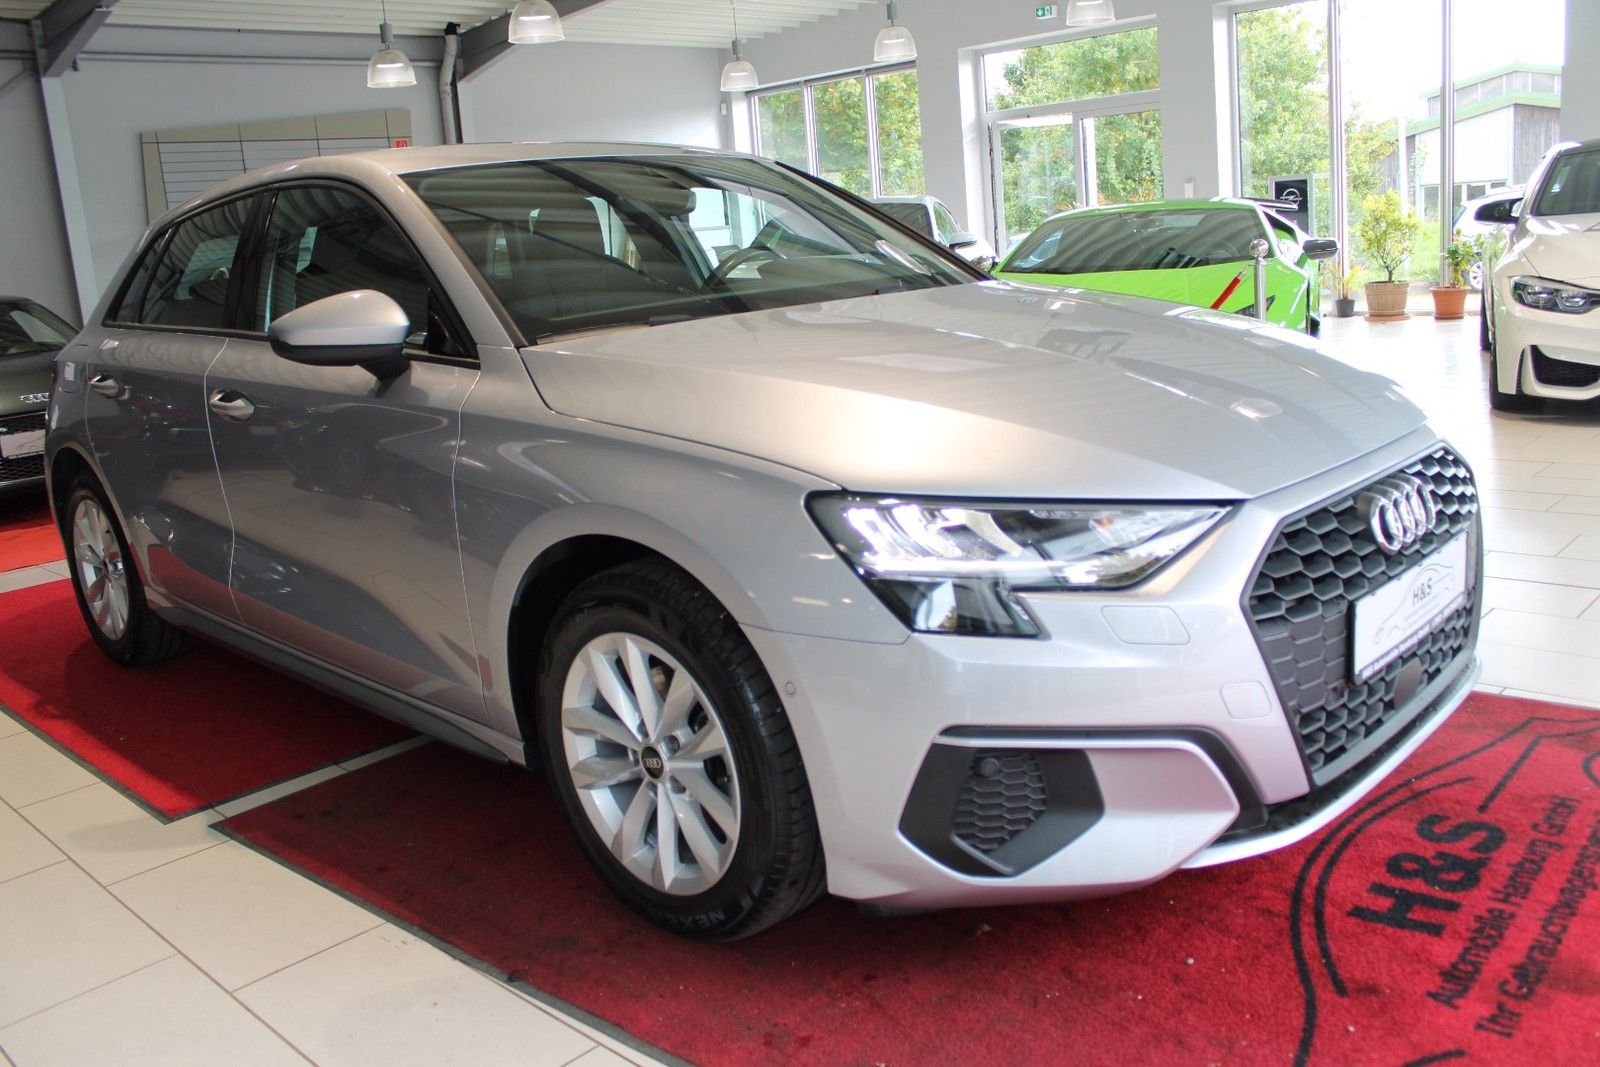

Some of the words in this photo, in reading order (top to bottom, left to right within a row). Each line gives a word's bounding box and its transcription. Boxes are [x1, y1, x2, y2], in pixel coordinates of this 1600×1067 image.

[1412, 578, 1433, 606] H&S
[1348, 814, 1506, 935] H&S
[1426, 907, 1517, 1009] Automobile
[1487, 837, 1565, 907] Hamburg
[1531, 796, 1582, 836] GmbH
[1474, 1000, 1524, 1039] Ihr
